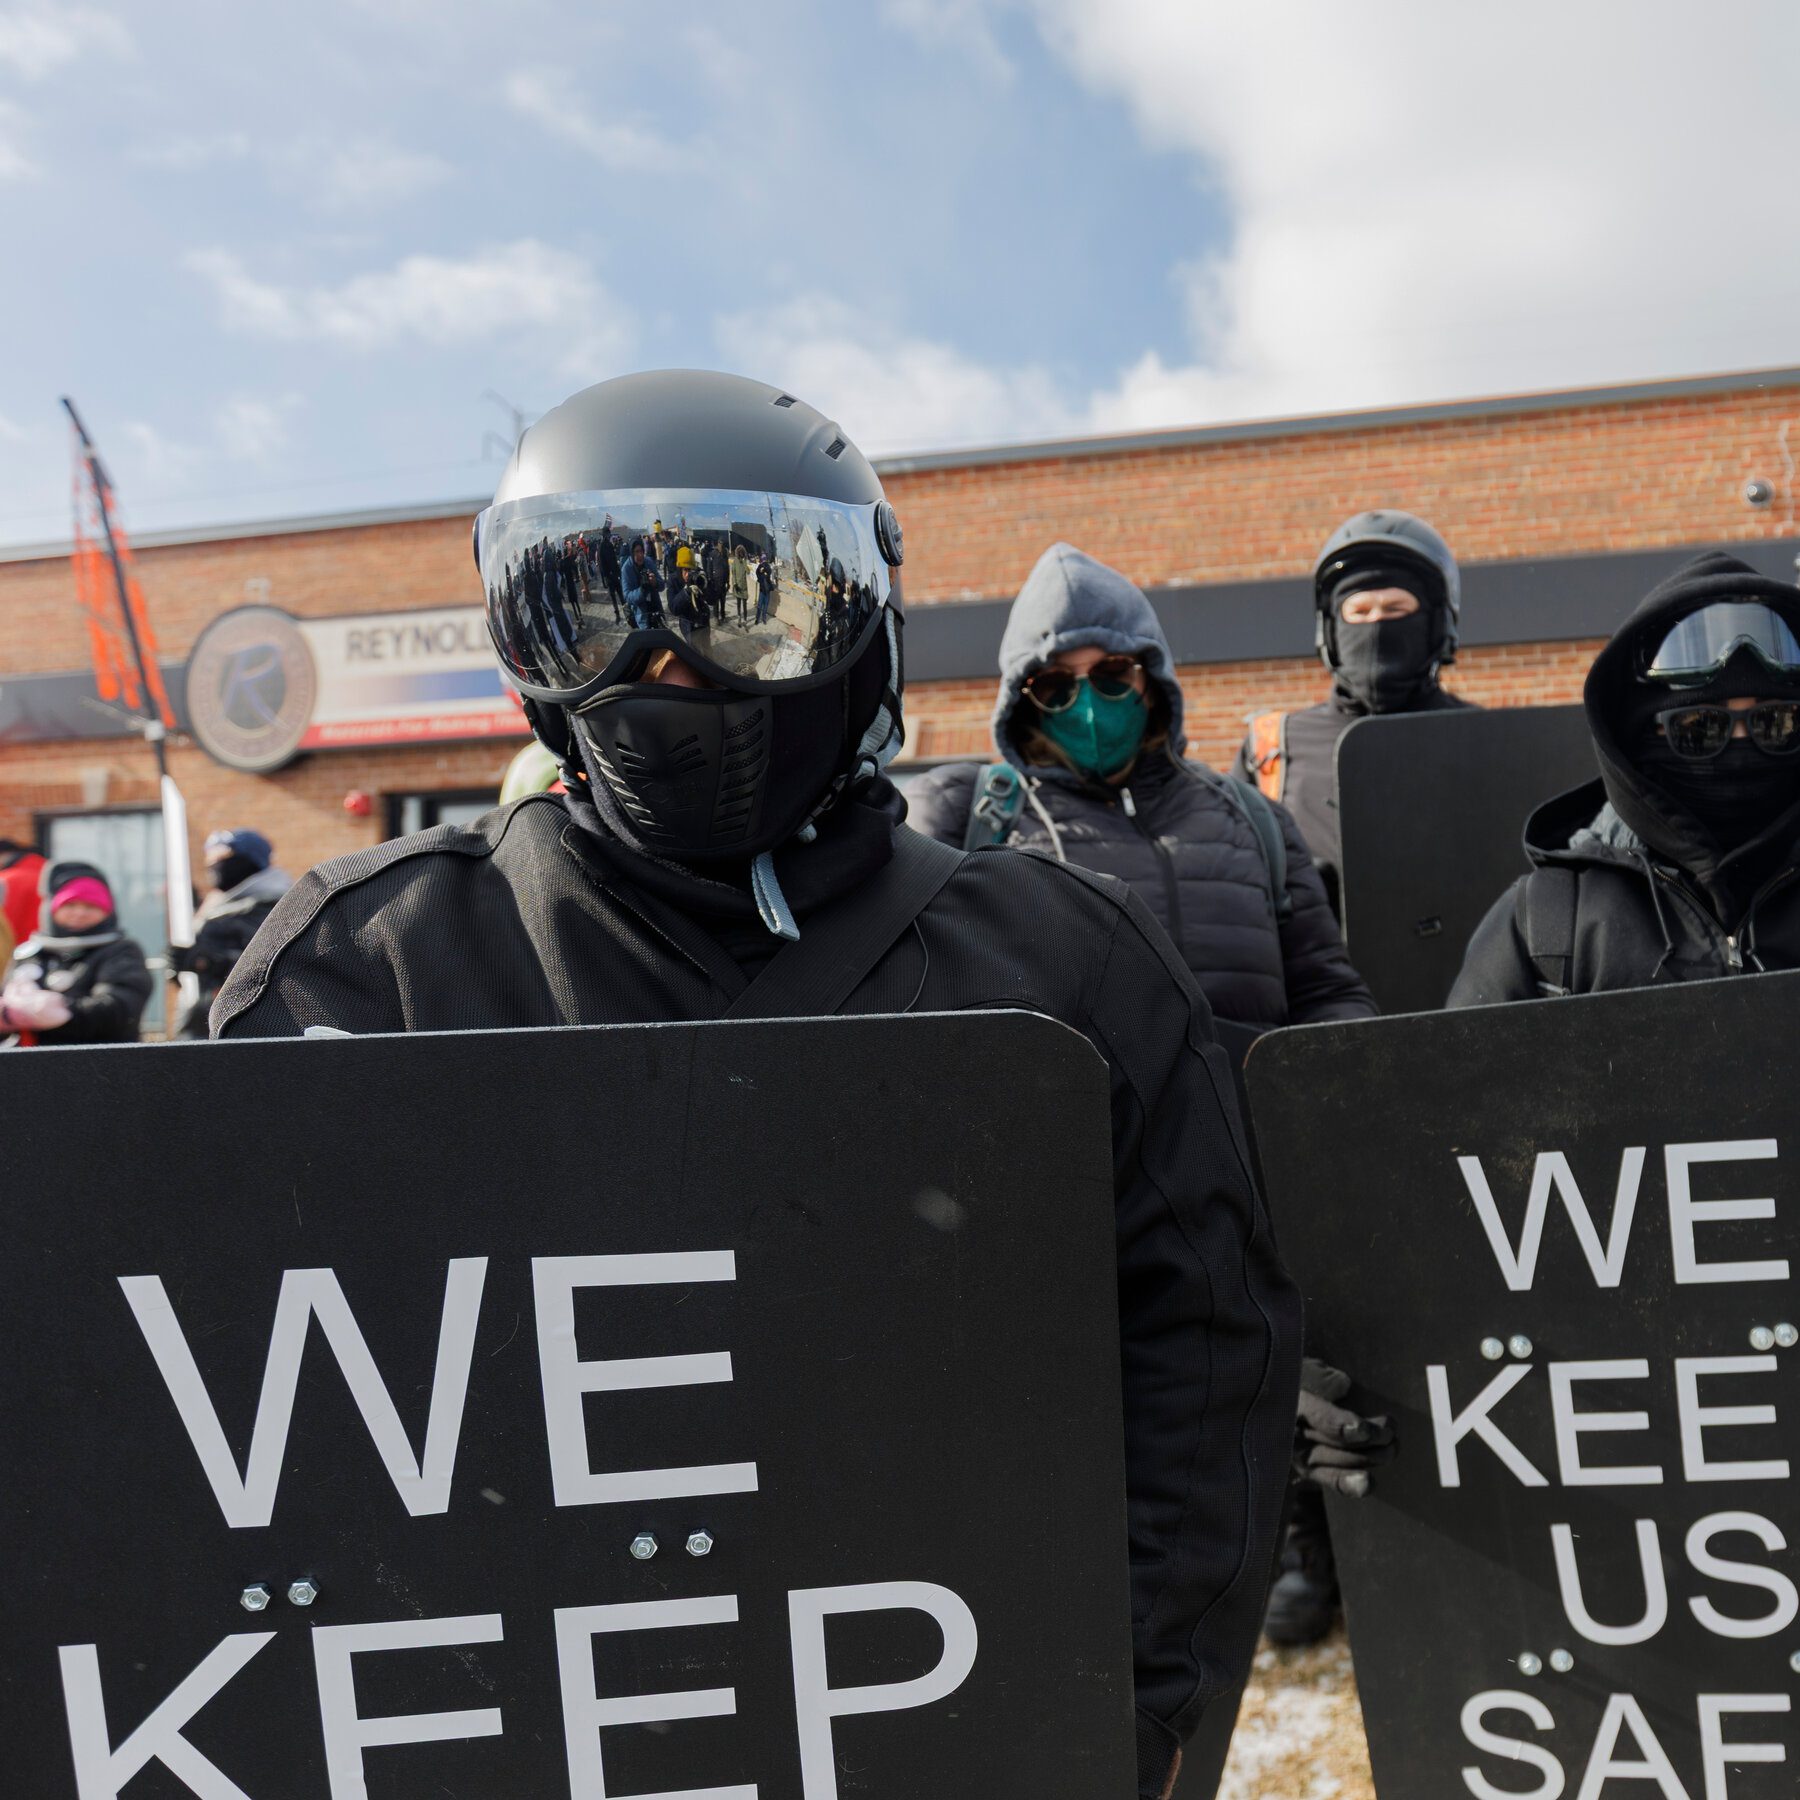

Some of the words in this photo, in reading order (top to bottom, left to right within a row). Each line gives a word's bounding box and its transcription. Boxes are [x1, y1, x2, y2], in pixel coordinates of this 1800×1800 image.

[1458, 1139, 1790, 1291] WE
[117, 1250, 759, 1529] WE
[1426, 1355, 1791, 1487] KEE
[1551, 1511, 1799, 1646] US
[58, 1580, 978, 1800] KEEP
